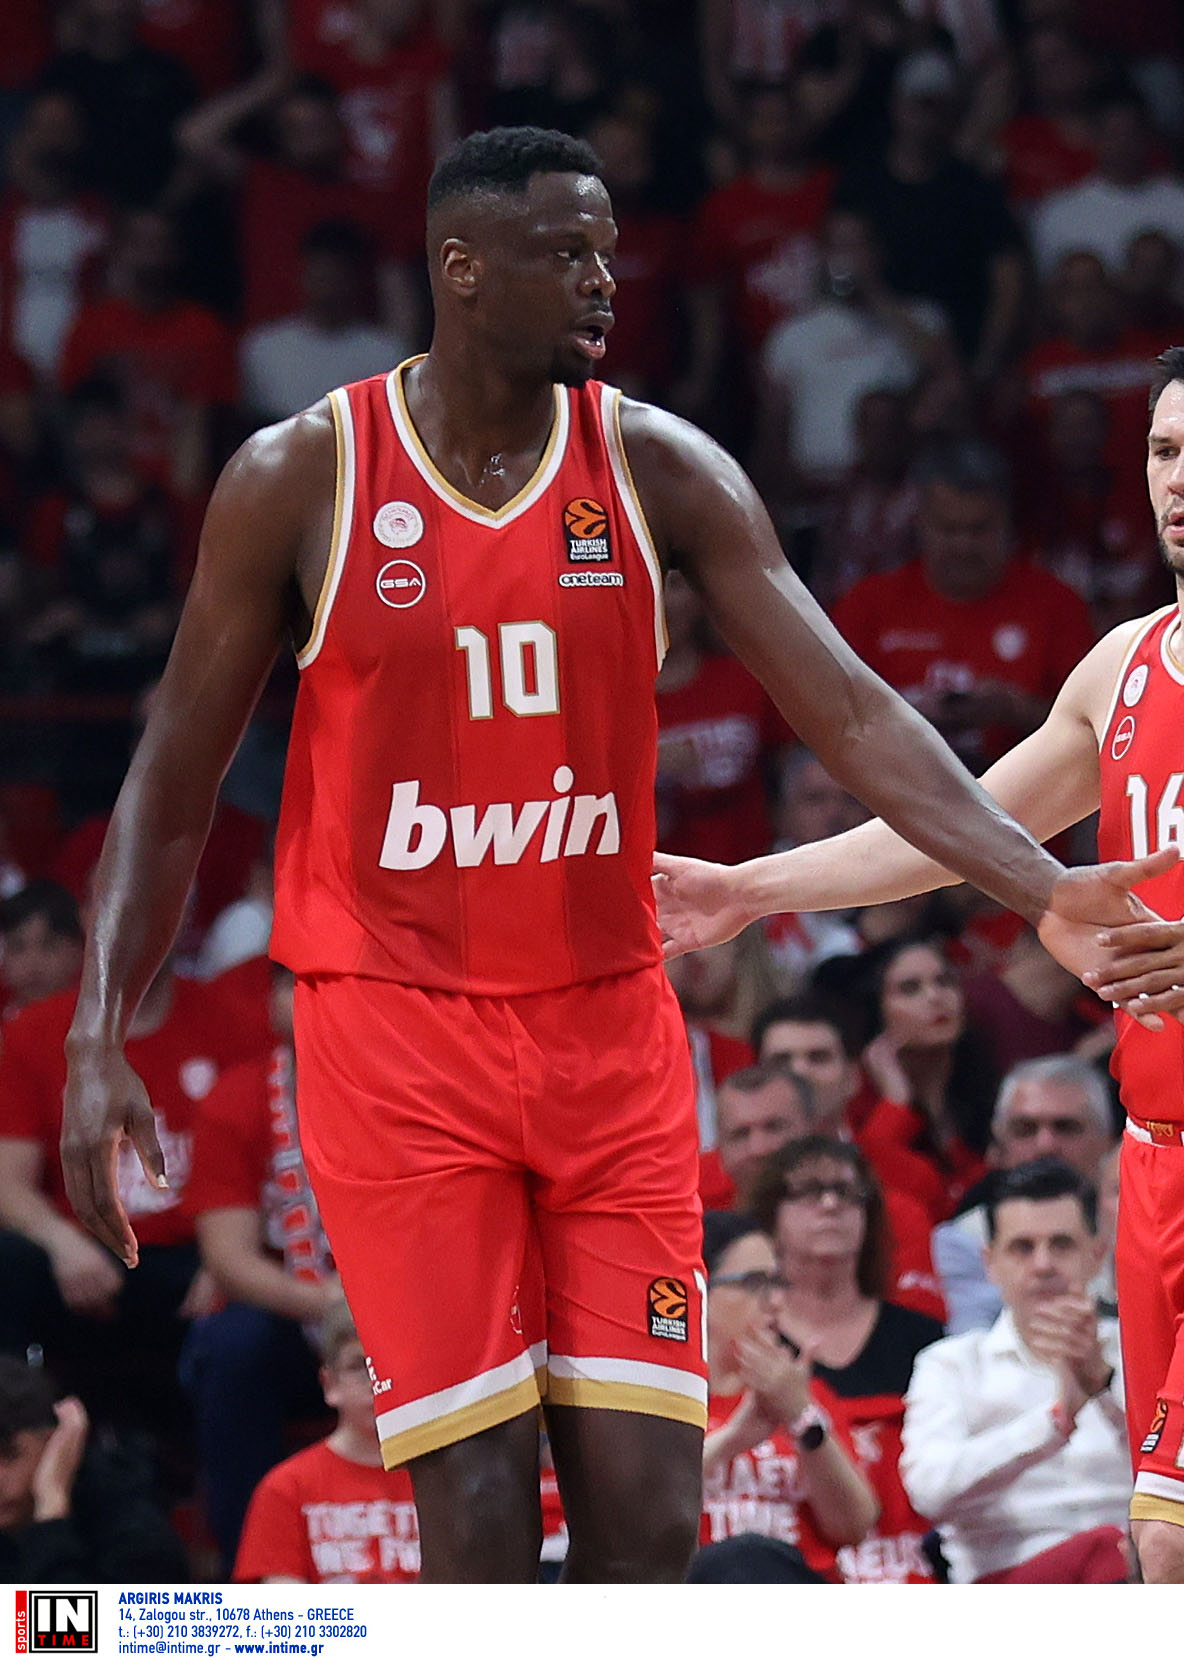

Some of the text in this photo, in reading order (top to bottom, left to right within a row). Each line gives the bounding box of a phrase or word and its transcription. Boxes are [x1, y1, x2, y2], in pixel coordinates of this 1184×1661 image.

[380, 578, 422, 589] GSA
[560, 572, 623, 586] oneteam
[454, 620, 560, 721] 10
[378, 765, 620, 870] bwin
